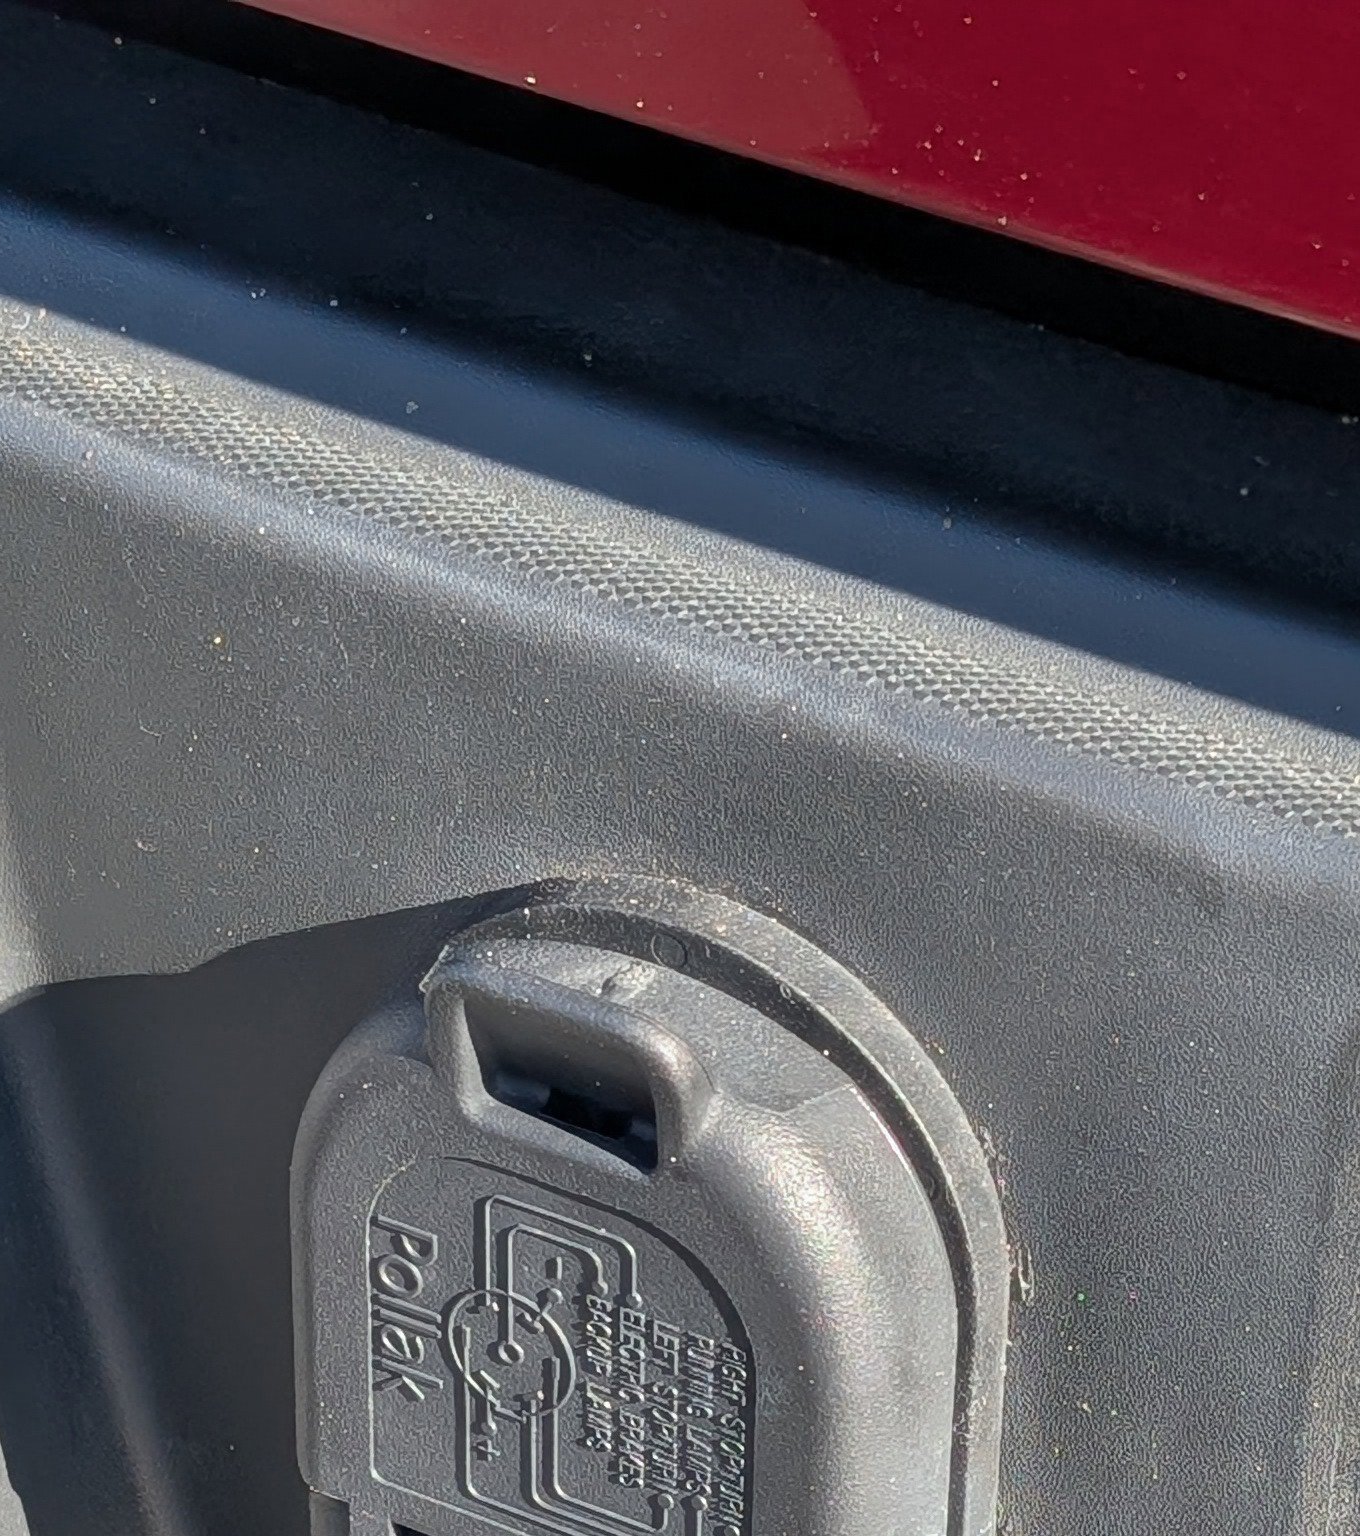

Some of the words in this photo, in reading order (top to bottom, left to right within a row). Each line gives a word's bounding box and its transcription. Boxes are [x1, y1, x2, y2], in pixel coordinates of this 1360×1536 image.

[370, 1214, 444, 1402] Pollak
[586, 1294, 610, 1376] BACKUP
[652, 1320, 678, 1376] LEFT
[618, 1307, 644, 1404] ELECTRIC
[686, 1331, 713, 1419] RUNNING
[720, 1341, 746, 1407] RIGHT
[585, 1381, 610, 1453] LAMPS
[617, 1407, 643, 1489] BRAKES
[684, 1423, 710, 1495] LAMPS
